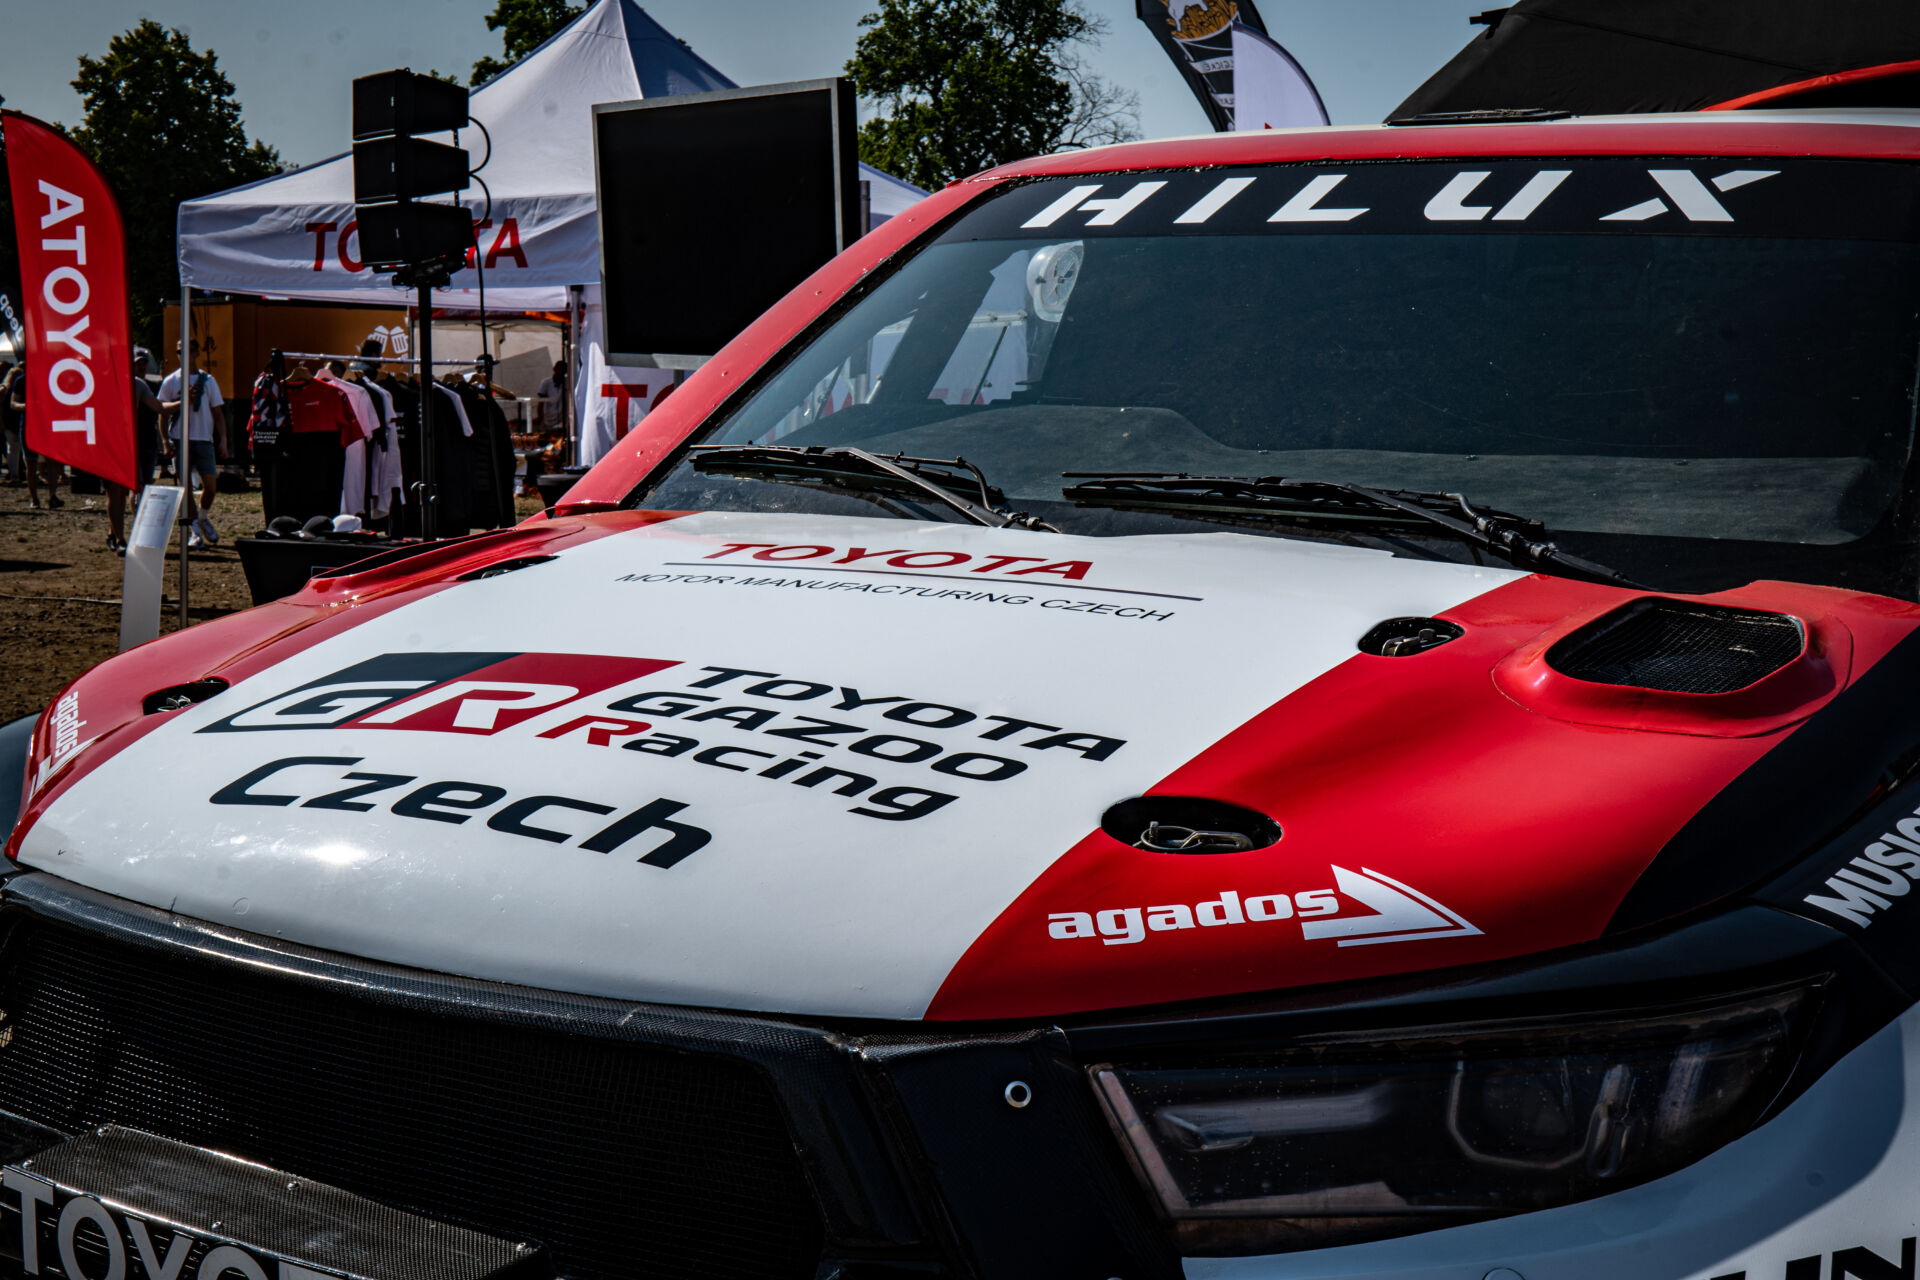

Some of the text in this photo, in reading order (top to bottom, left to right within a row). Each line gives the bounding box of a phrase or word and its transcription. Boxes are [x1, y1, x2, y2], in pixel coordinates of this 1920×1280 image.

[1020, 170, 1780, 229] HILUX
[305, 217, 528, 273] TOTA
[703, 543, 1093, 580] TOYOTA
[615, 573, 1176, 622] MOTOR MANUFACTURING CZECH
[50, 691, 87, 758] agados
[228, 680, 580, 735] GR
[606, 691, 1029, 782] GAZOO
[688, 665, 1128, 762] TOYOTA
[535, 714, 961, 822] Racing
[209, 756, 713, 870] Czech
[1047, 888, 1341, 946] agados
[2, 1165, 347, 1280] TOY
